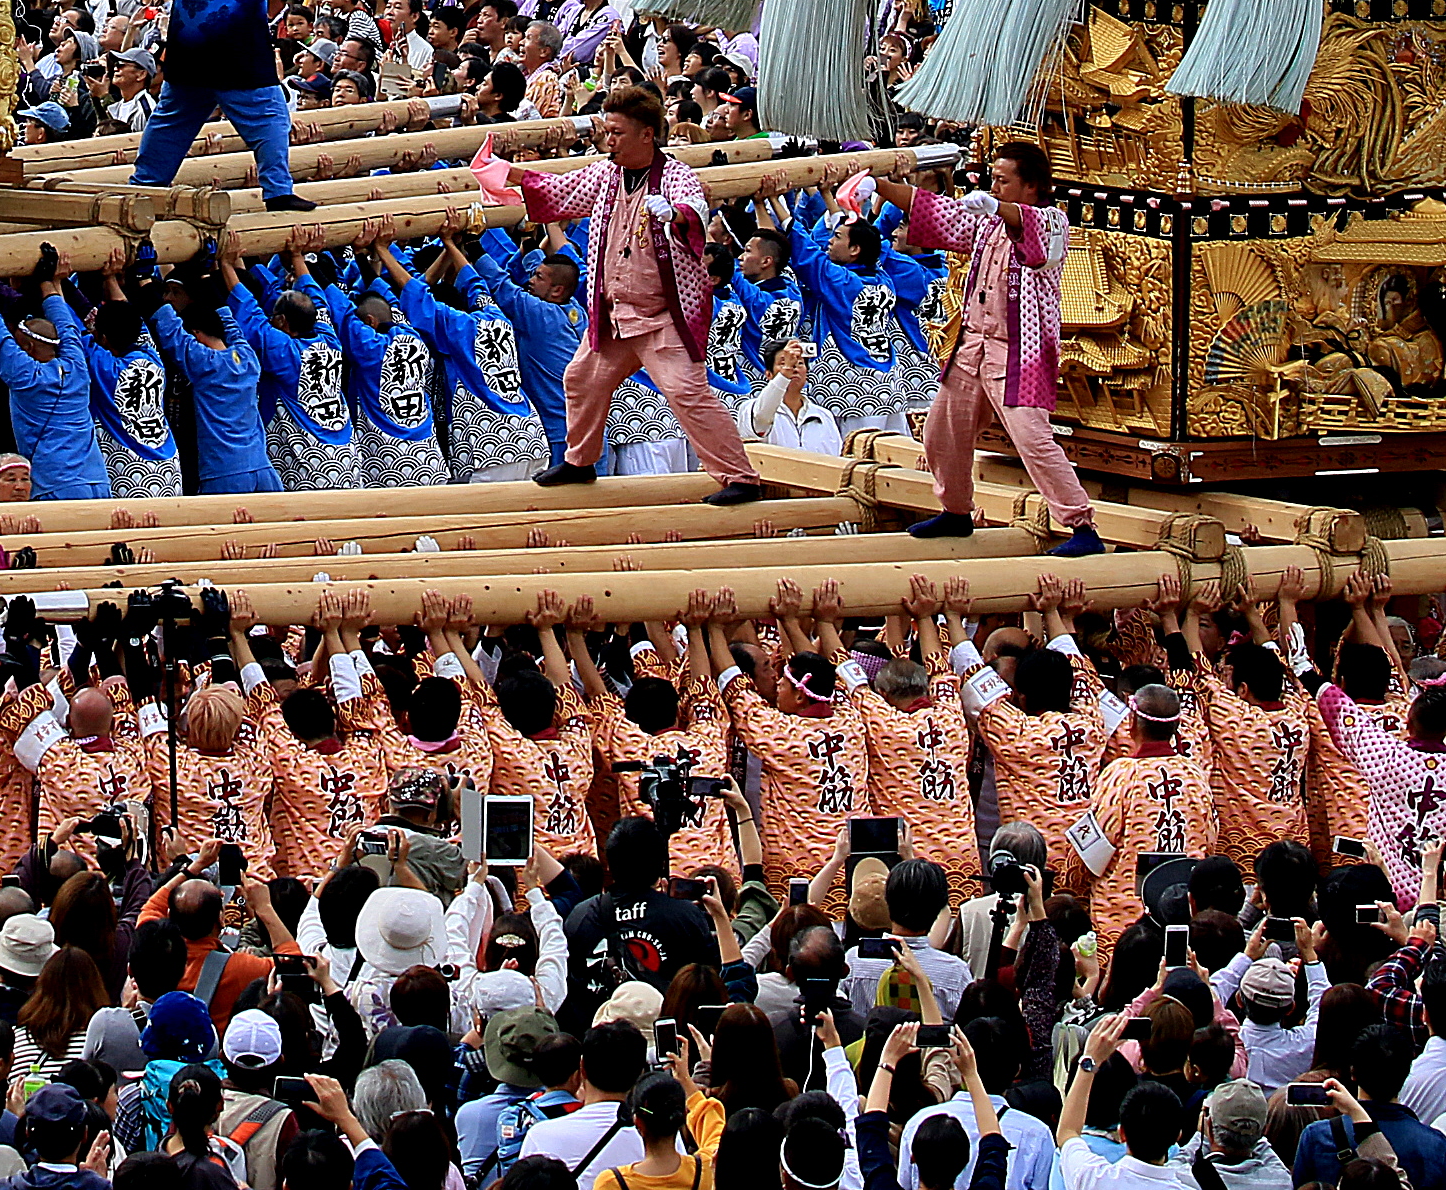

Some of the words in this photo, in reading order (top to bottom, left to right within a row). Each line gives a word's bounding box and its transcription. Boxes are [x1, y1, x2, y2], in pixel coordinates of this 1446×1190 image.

[480, 324, 520, 395] 新田
[857, 290, 893, 358] 新田
[126, 370, 164, 441] 新田
[307, 351, 342, 422] 新田
[389, 341, 426, 420] 新田
[544, 751, 576, 834] 中筋
[808, 730, 854, 814] 中筋
[917, 716, 955, 801] 中筋
[1050, 720, 1091, 803] 中筋
[209, 767, 246, 842] 中筋
[1148, 767, 1186, 852] 中筋
